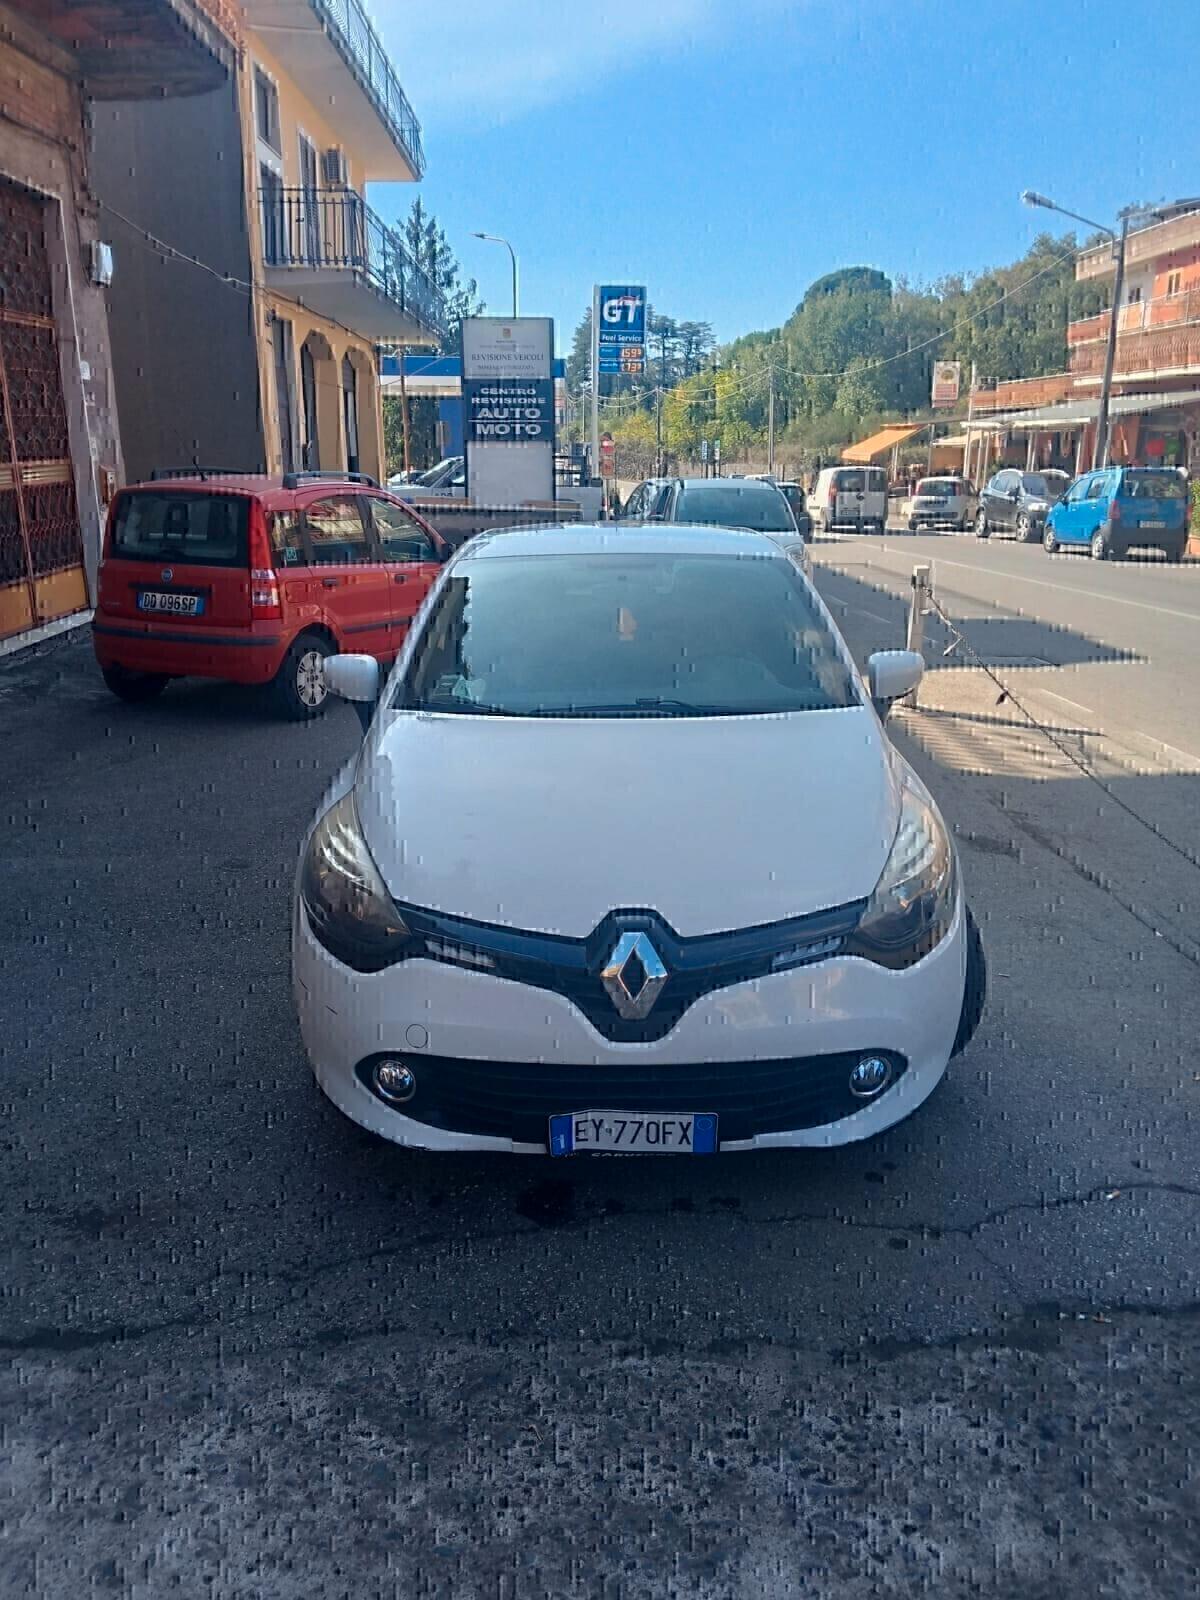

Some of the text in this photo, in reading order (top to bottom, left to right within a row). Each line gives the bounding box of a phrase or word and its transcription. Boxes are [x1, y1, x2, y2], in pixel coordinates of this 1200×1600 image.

[602, 299, 641, 323] GT
[601, 333, 642, 342] Fuel Service
[471, 353, 544, 361] REVISIONE VEICOLI
[477, 407, 541, 418] AUTO
[477, 423, 542, 435] MOTO
[575, 1119, 692, 1145] EY 770FX
